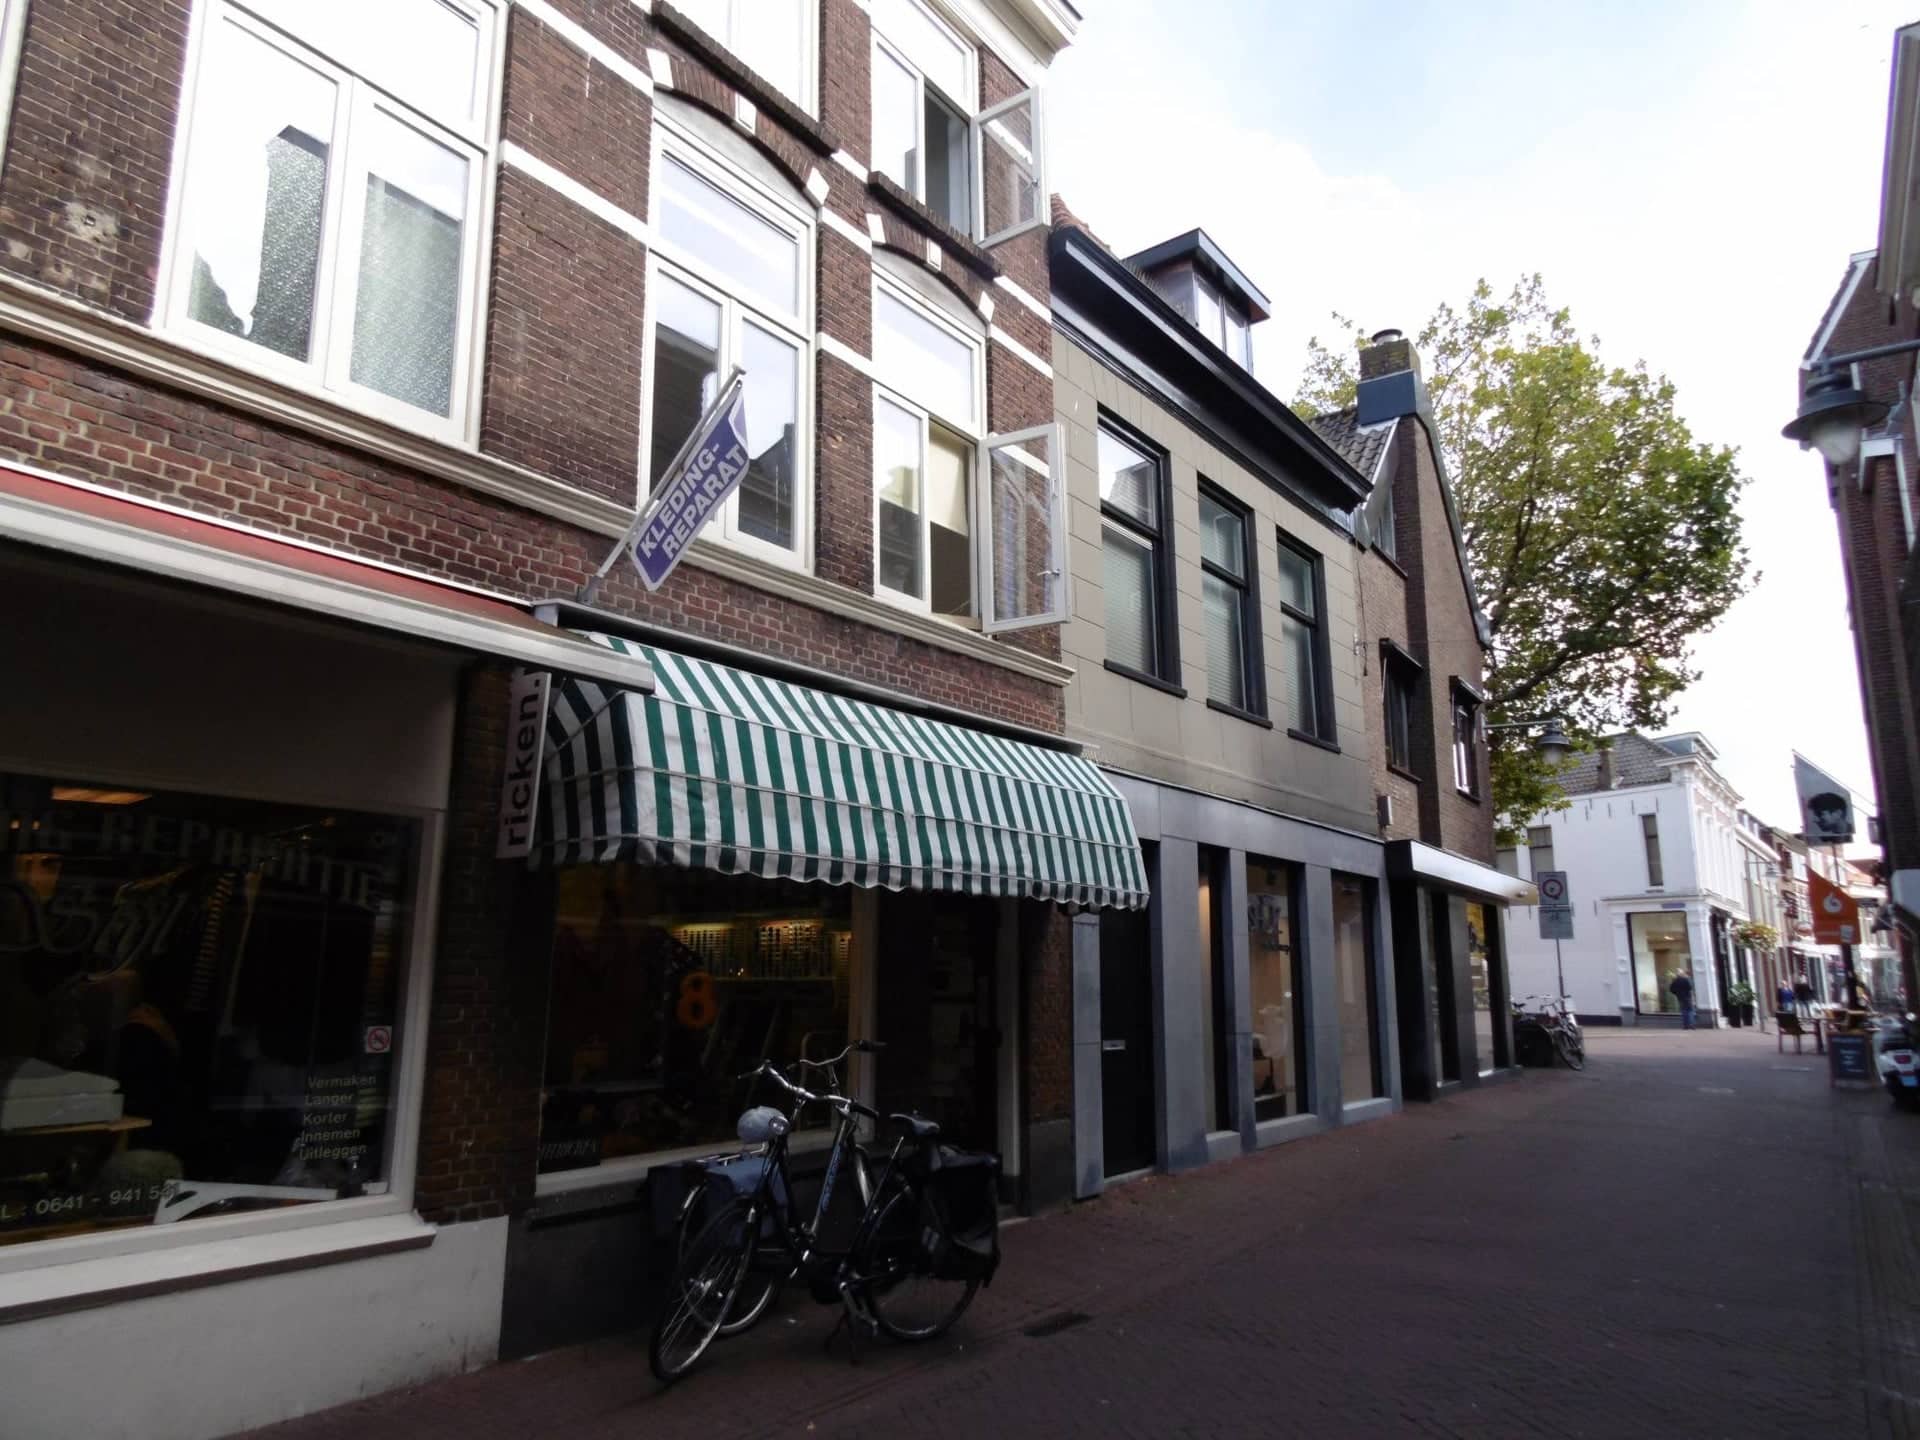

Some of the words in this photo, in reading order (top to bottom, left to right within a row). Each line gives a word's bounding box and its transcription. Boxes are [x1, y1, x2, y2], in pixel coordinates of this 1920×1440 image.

[640, 443, 720, 559] KLEDING-
[662, 445, 747, 560] REPARAT
[35, 1193, 84, 1215] 0641
[109, 1188, 142, 1206] 941
